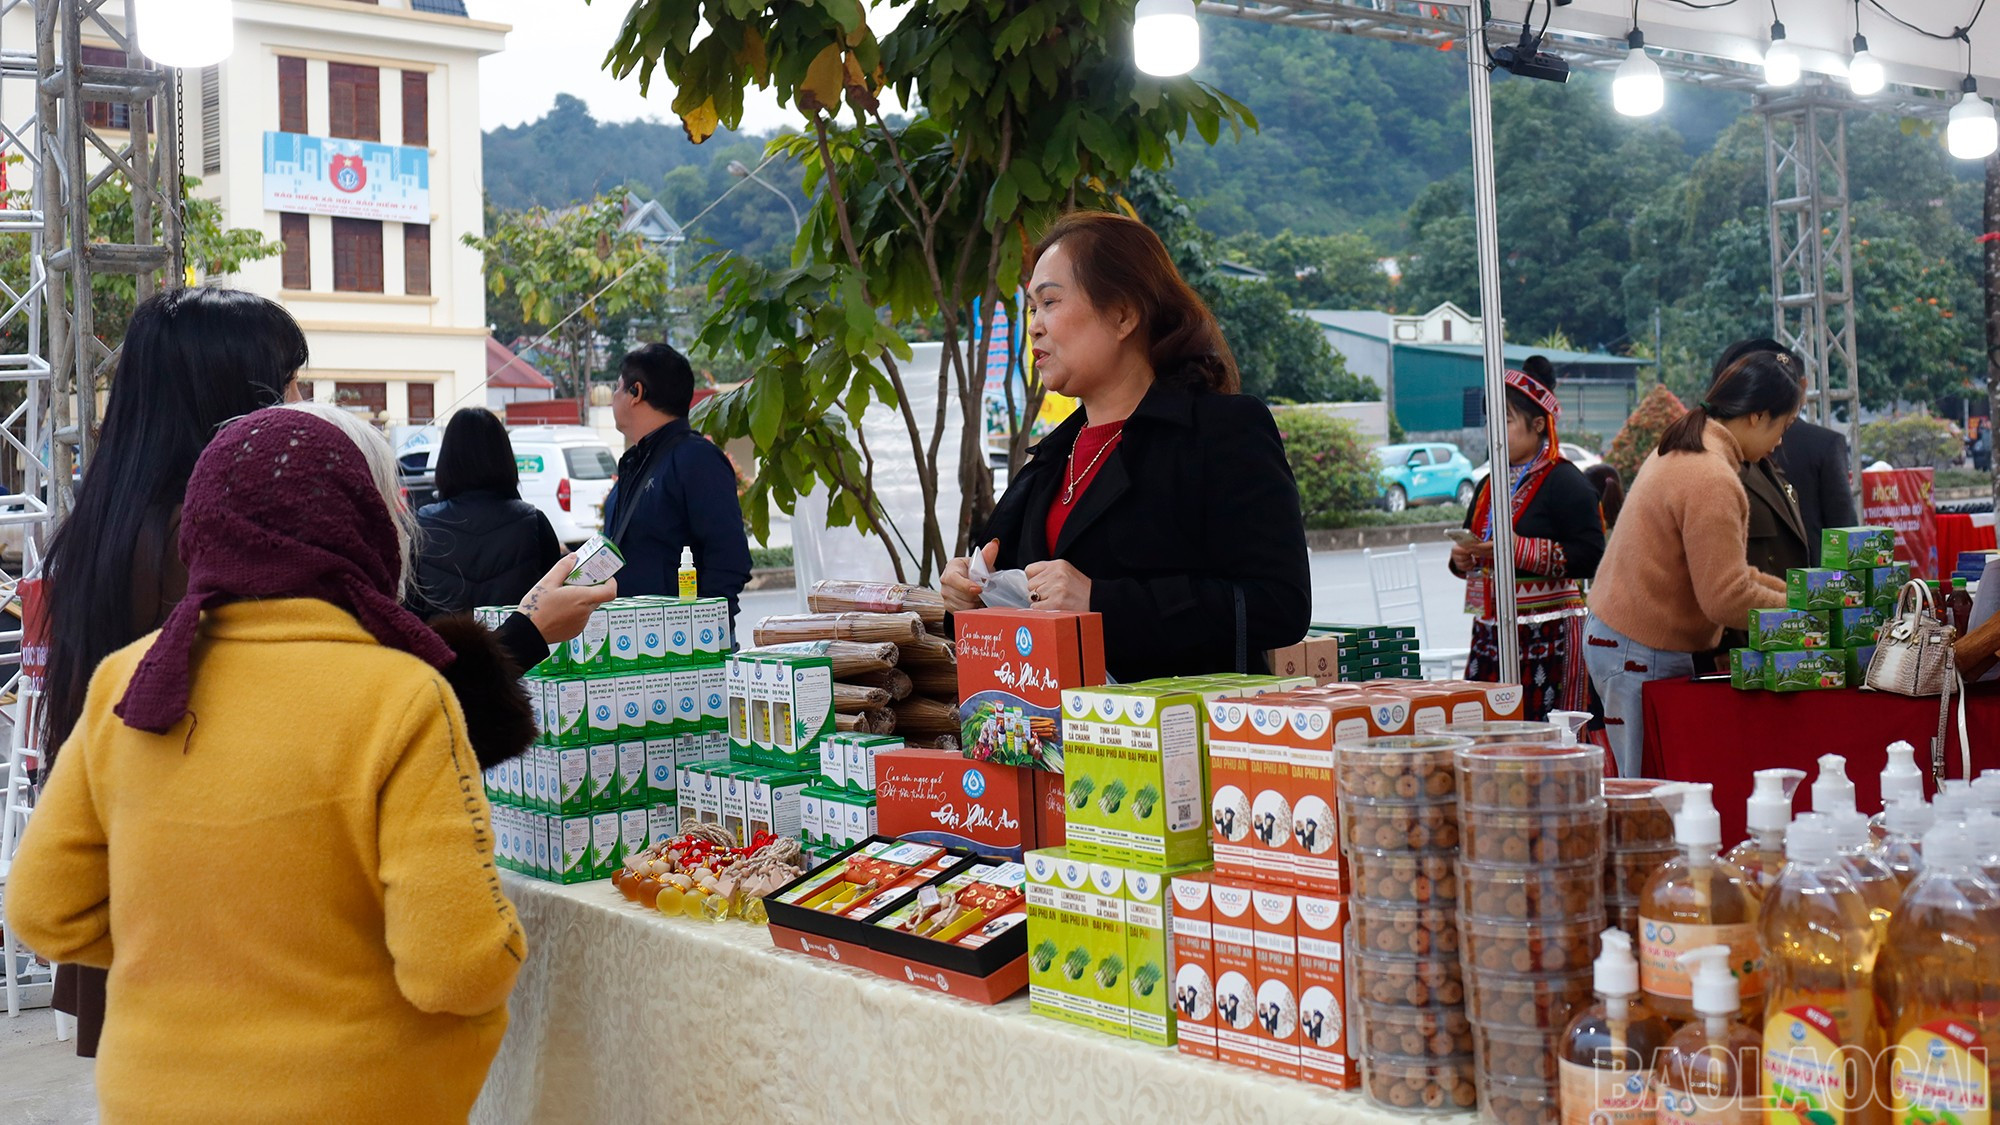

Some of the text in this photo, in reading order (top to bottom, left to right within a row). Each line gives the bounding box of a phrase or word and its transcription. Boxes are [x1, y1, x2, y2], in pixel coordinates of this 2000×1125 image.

[1494, 692, 1516, 702] OCOP
[1068, 722, 1088, 732] TINH DẦU
[1099, 725, 1120, 735] TINH DẦU
[1130, 728, 1151, 738] TINH DẦU
[1075, 733, 1091, 742] CHANH
[1106, 736, 1122, 745] CHANH
[1087, 746, 1095, 754] AN
[1138, 740, 1153, 749] CHANH
[1118, 750, 1127, 759] AN
[1149, 754, 1157, 763] AN
[1211, 757, 1247, 771] DAI PHU AN
[1251, 761, 1288, 775] DAI PHU AN
[1291, 766, 1331, 780] DAI PHU AN
[994, 807, 1019, 831] An
[1029, 884, 1053, 897] LEMONGRASS
[1061, 890, 1086, 903] LEMONGRASS
[1179, 885, 1200, 896] OCOP
[1219, 890, 1242, 902] OCOP
[1029, 895, 1048, 905] ESSENTIAL
[1060, 900, 1080, 912] ESSENTIAL
[1097, 898, 1106, 908] TINH
[1261, 897, 1284, 909] OCOP
[1028, 906, 1056, 921] DAI PHU AN
[1305, 902, 1329, 914] OCOP
[1060, 912, 1089, 928] DAI PHU AN
[1103, 910, 1119, 920] CHANH
[1129, 926, 1139, 938] DAI
[1201, 940, 1210, 951] AN
[1242, 947, 1253, 958] AN
[1284, 955, 1294, 967] AN
[1328, 961, 1340, 973] AN
[1806, 1007, 1832, 1028] NEW
[1946, 1023, 1976, 1043] NEW
